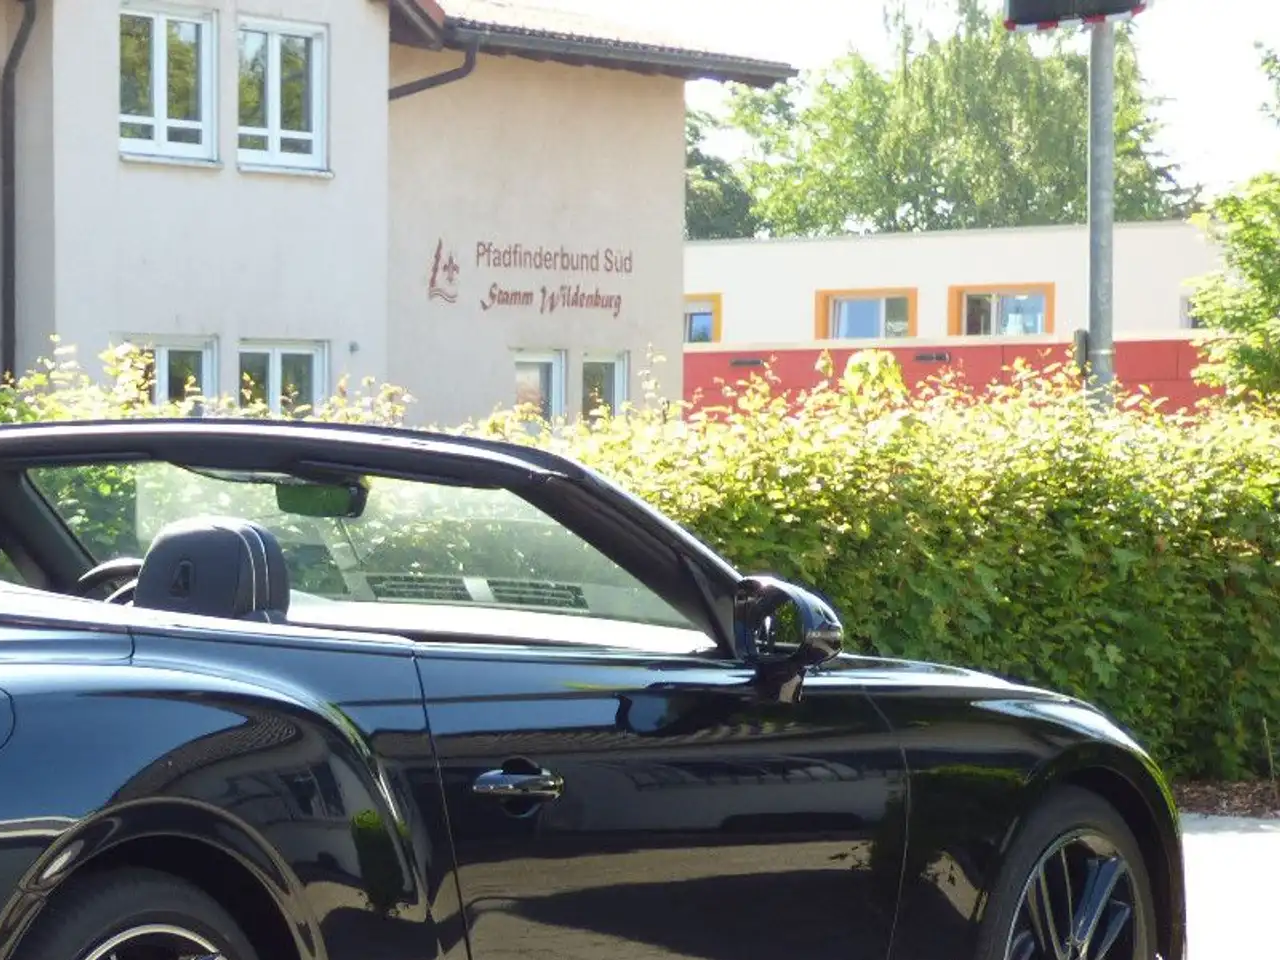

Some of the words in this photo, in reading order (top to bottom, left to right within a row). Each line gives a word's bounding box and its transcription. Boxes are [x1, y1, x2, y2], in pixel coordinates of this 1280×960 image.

[476, 240, 600, 272] Pfadfinderbund
[479, 282, 534, 312] Stamm
[539, 284, 622, 319] Wildenburg
